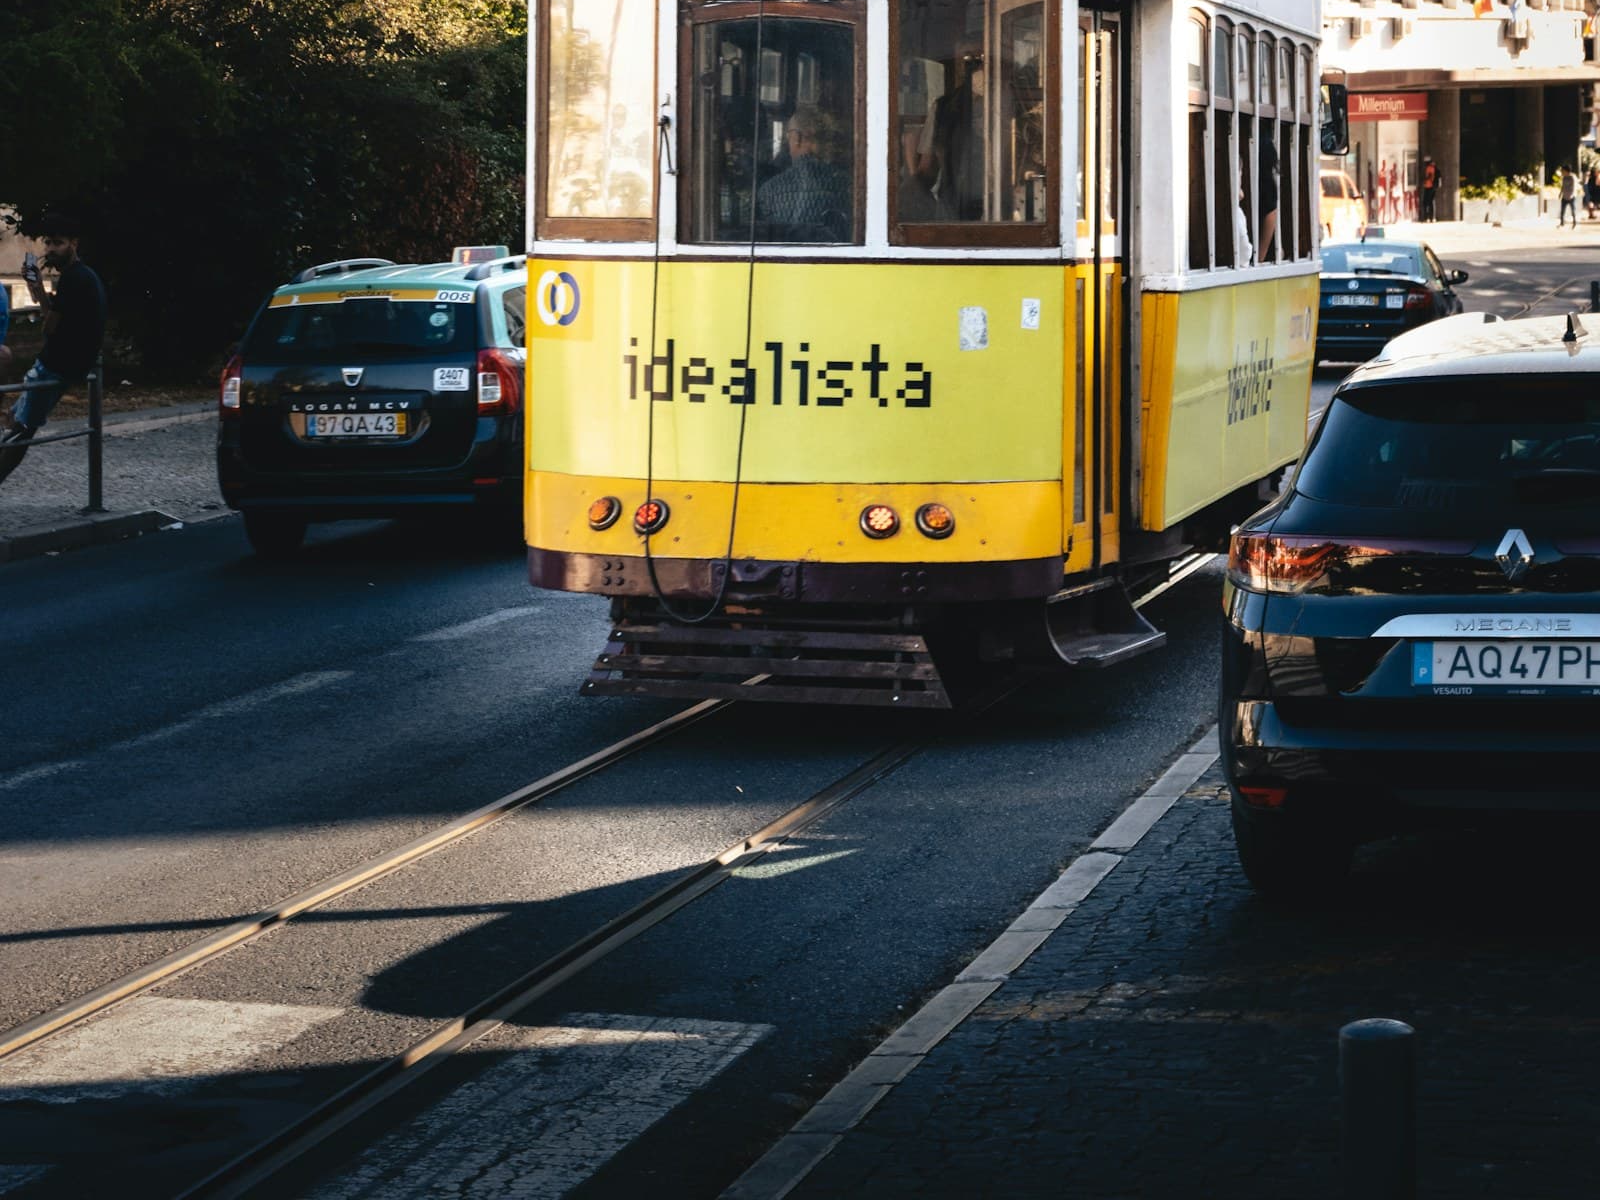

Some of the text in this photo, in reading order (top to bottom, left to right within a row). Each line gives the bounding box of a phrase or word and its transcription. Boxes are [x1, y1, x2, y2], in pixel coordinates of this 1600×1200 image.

[1359, 95, 1405, 113] Millennium
[438, 291, 471, 302] 008
[440, 369, 464, 380] 2407
[623, 337, 932, 408] idealista
[291, 403, 357, 411] LOGAN
[1455, 618, 1572, 631] MEGANE
[1433, 687, 1473, 695] VESAUTO
